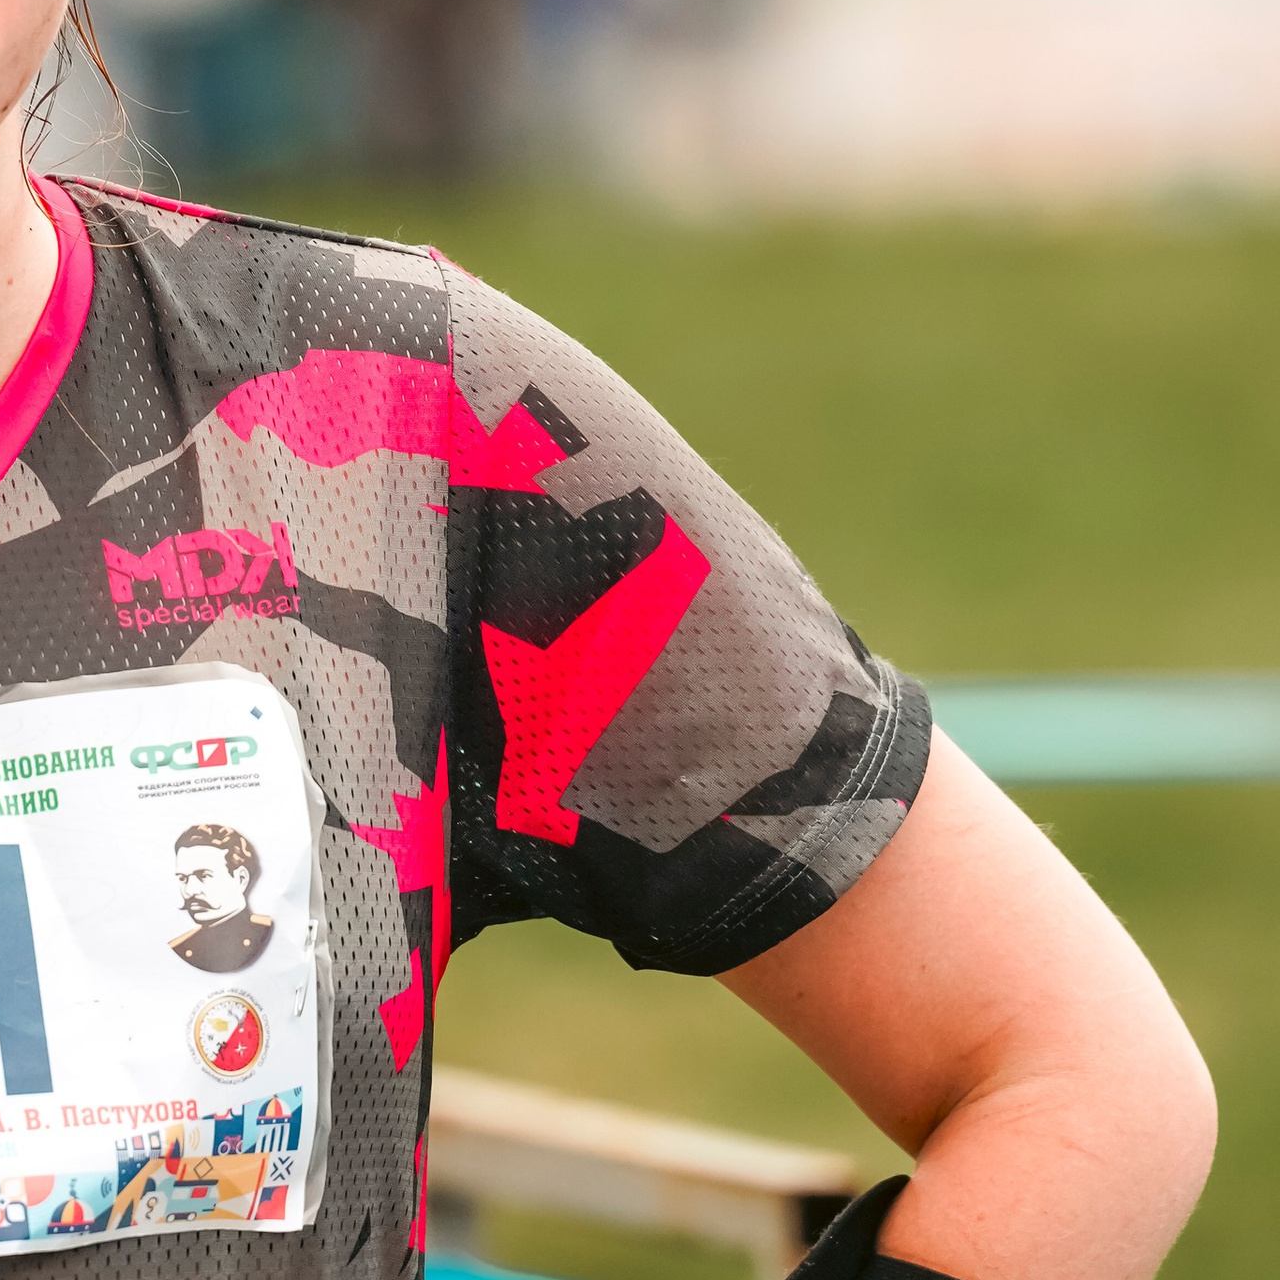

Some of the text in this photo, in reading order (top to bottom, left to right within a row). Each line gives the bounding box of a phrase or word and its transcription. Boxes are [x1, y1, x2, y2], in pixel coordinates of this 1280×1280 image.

[117, 593, 302, 633] special wear
[137, 772, 260, 791] ФЕДЕРАЦИЯ СПОРТИВНОГО
[138, 781, 261, 799] ОРИЕНТИРОВАНИЯ РОССИИ
[26, 1107, 51, 1131] В.
[61, 1098, 200, 1130] Пастухова
